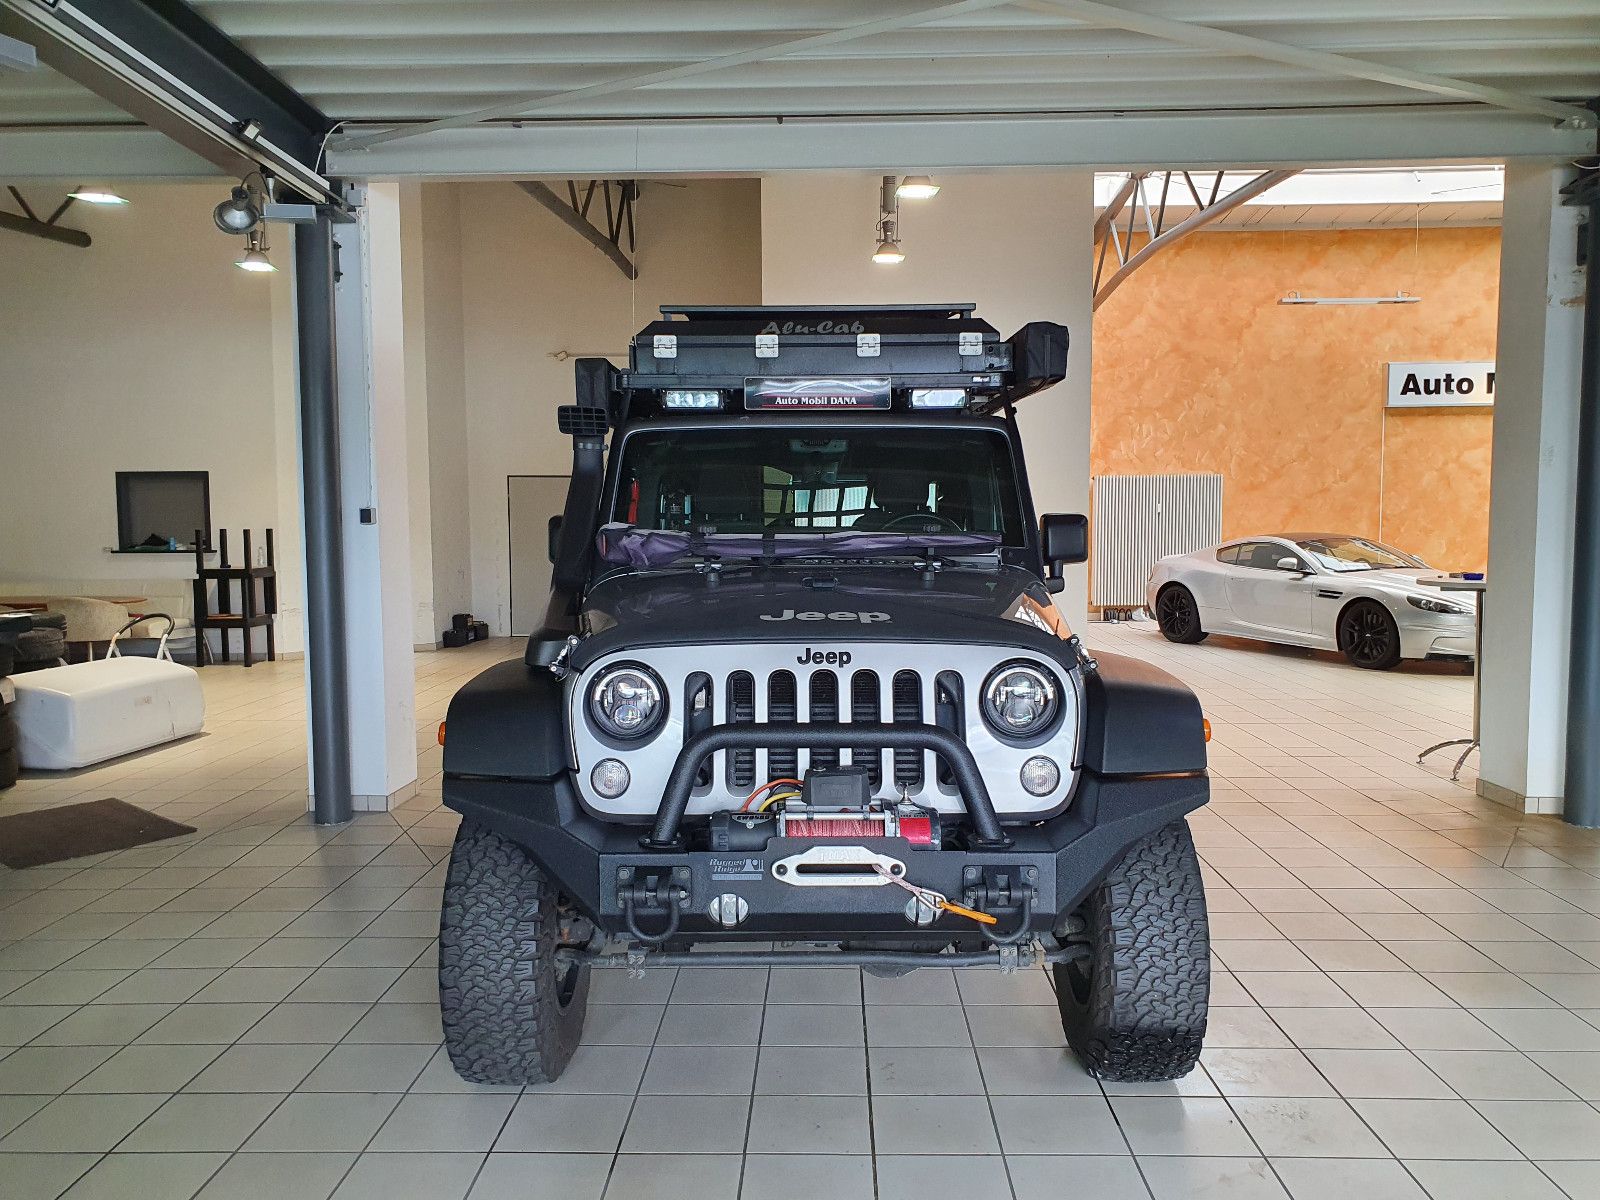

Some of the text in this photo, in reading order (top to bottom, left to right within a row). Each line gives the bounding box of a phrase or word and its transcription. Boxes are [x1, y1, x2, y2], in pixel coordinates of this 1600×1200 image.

[761, 320, 865, 335] Alu-Cab
[1400, 373, 1475, 396] Auto
[775, 396, 857, 405] Auto Mobil DANA
[759, 609, 893, 624] Jeep
[796, 647, 852, 668] Jeep
